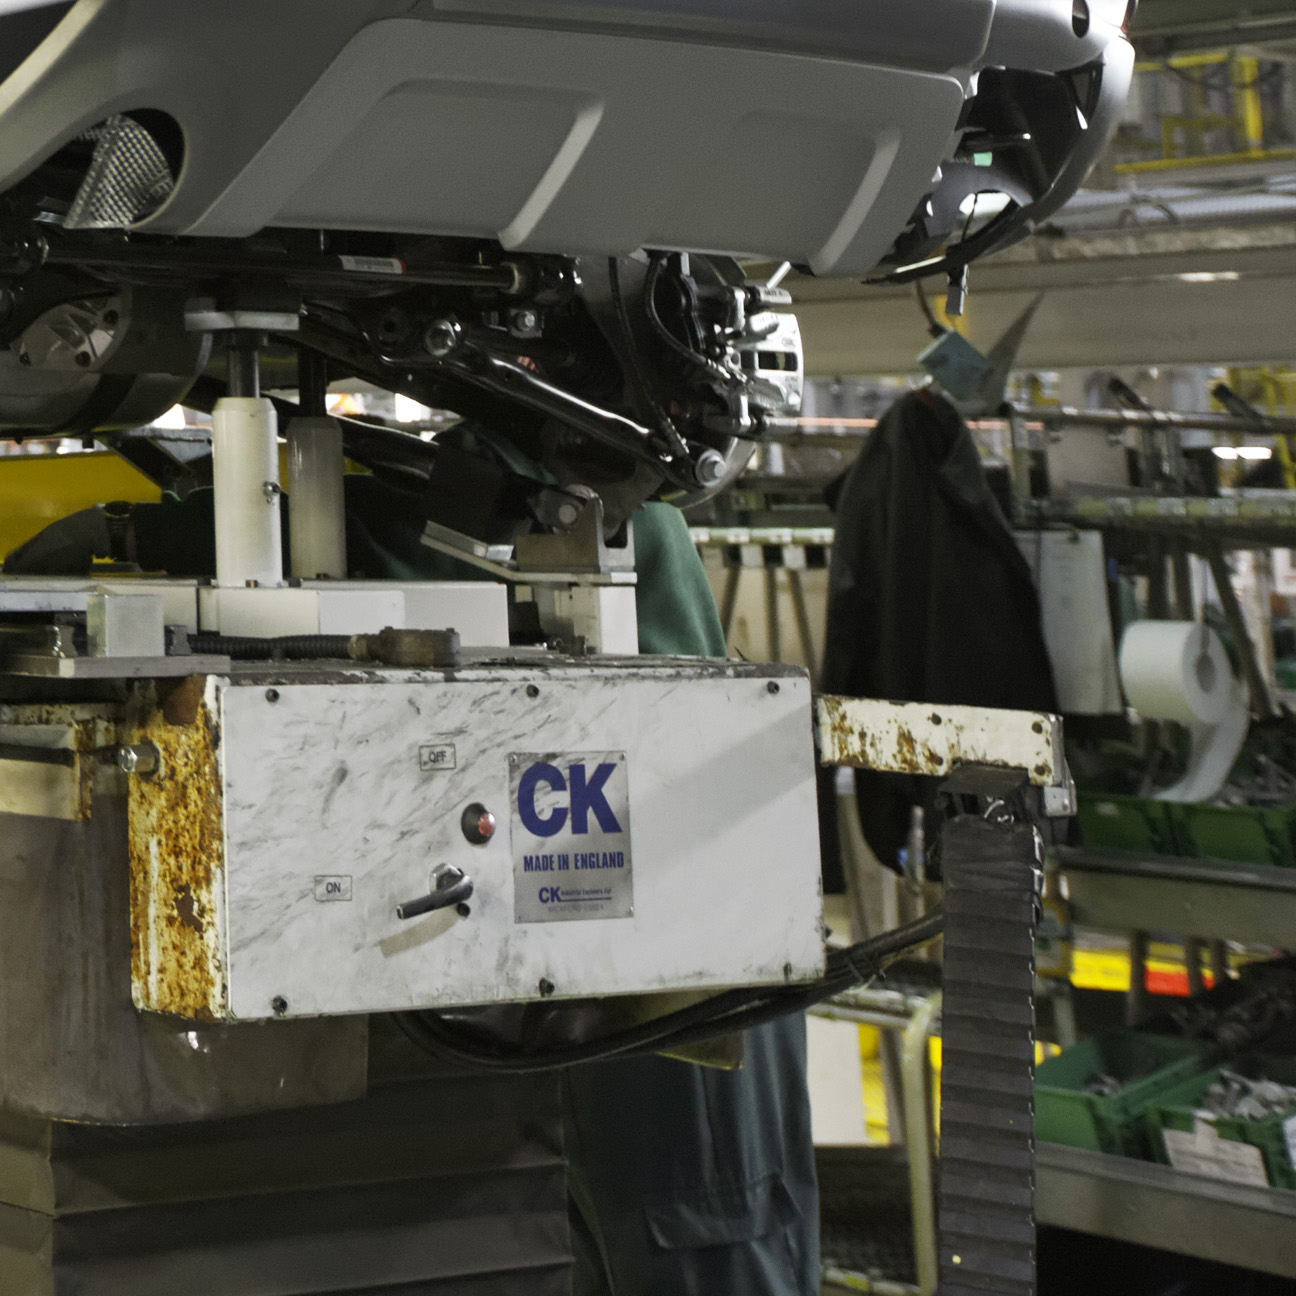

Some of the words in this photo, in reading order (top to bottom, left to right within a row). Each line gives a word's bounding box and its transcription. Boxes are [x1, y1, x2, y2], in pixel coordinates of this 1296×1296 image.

[428, 750, 447, 764] OFF
[517, 762, 622, 837] CK
[523, 854, 555, 873] MADE
[557, 854, 570, 871] IN
[574, 851, 625, 870] ENGLAND
[325, 881, 341, 894] ON
[538, 886, 561, 903] CK
